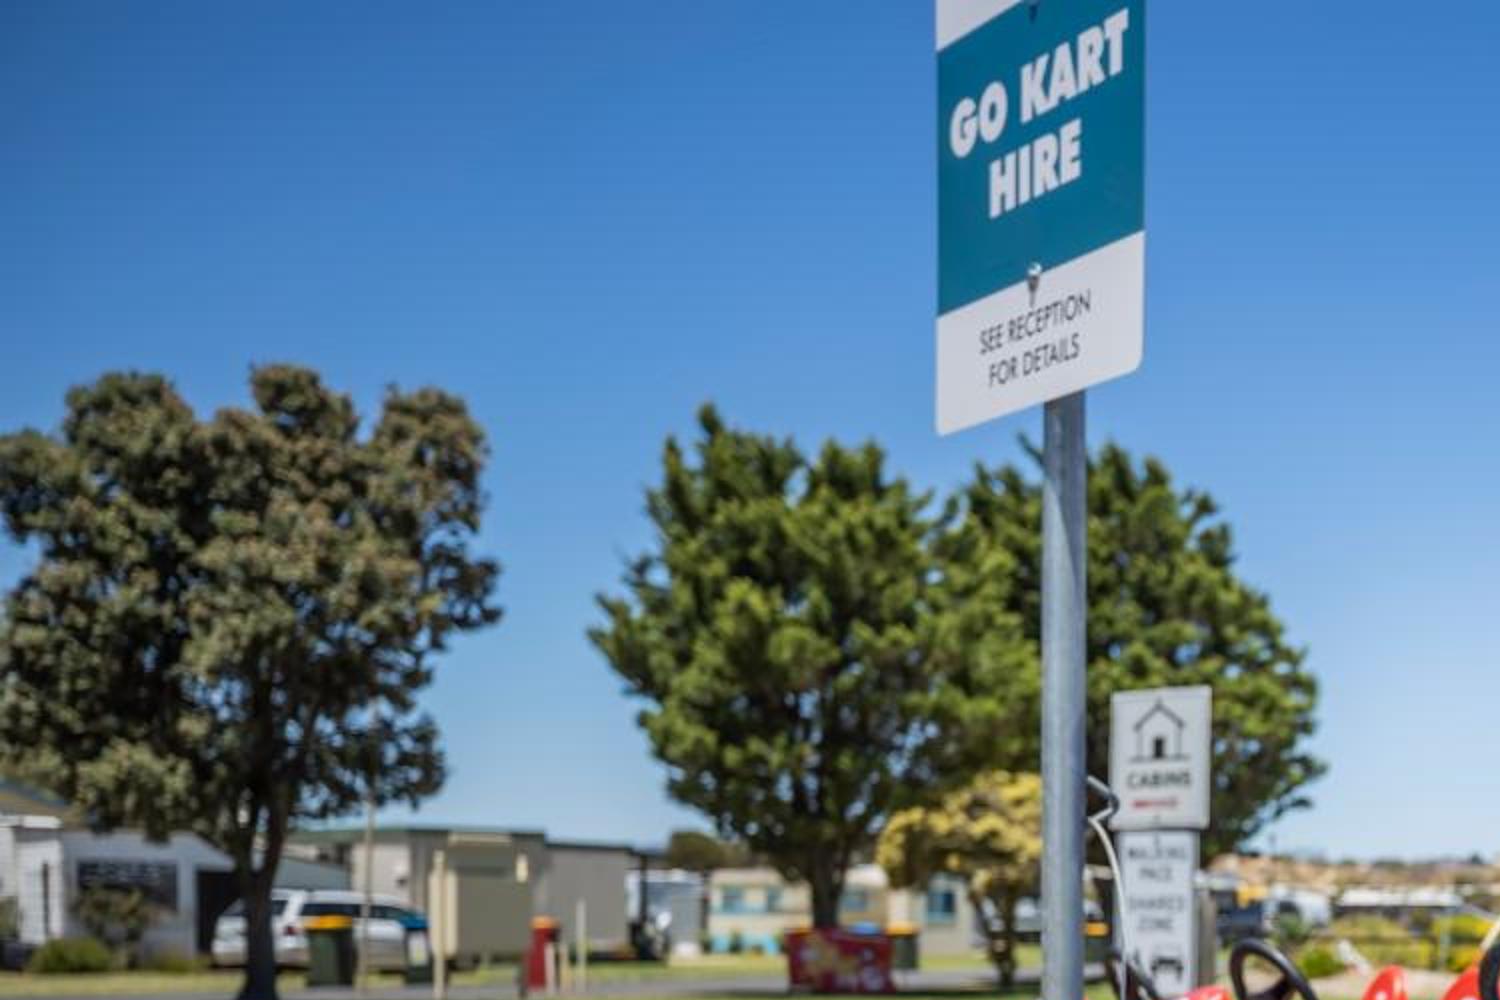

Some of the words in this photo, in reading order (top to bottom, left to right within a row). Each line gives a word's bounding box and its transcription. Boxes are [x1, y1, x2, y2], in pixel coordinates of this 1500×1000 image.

[950, 81, 1007, 158] GO
[1020, 9, 1129, 125] KART
[989, 118, 1082, 219] HIRE
[980, 323, 1003, 354] SEE
[1008, 288, 1090, 340] RECEPTION
[989, 357, 1018, 388] FOR
[1023, 333, 1079, 376] DETAILS
[1127, 771, 1191, 788] CABINS
